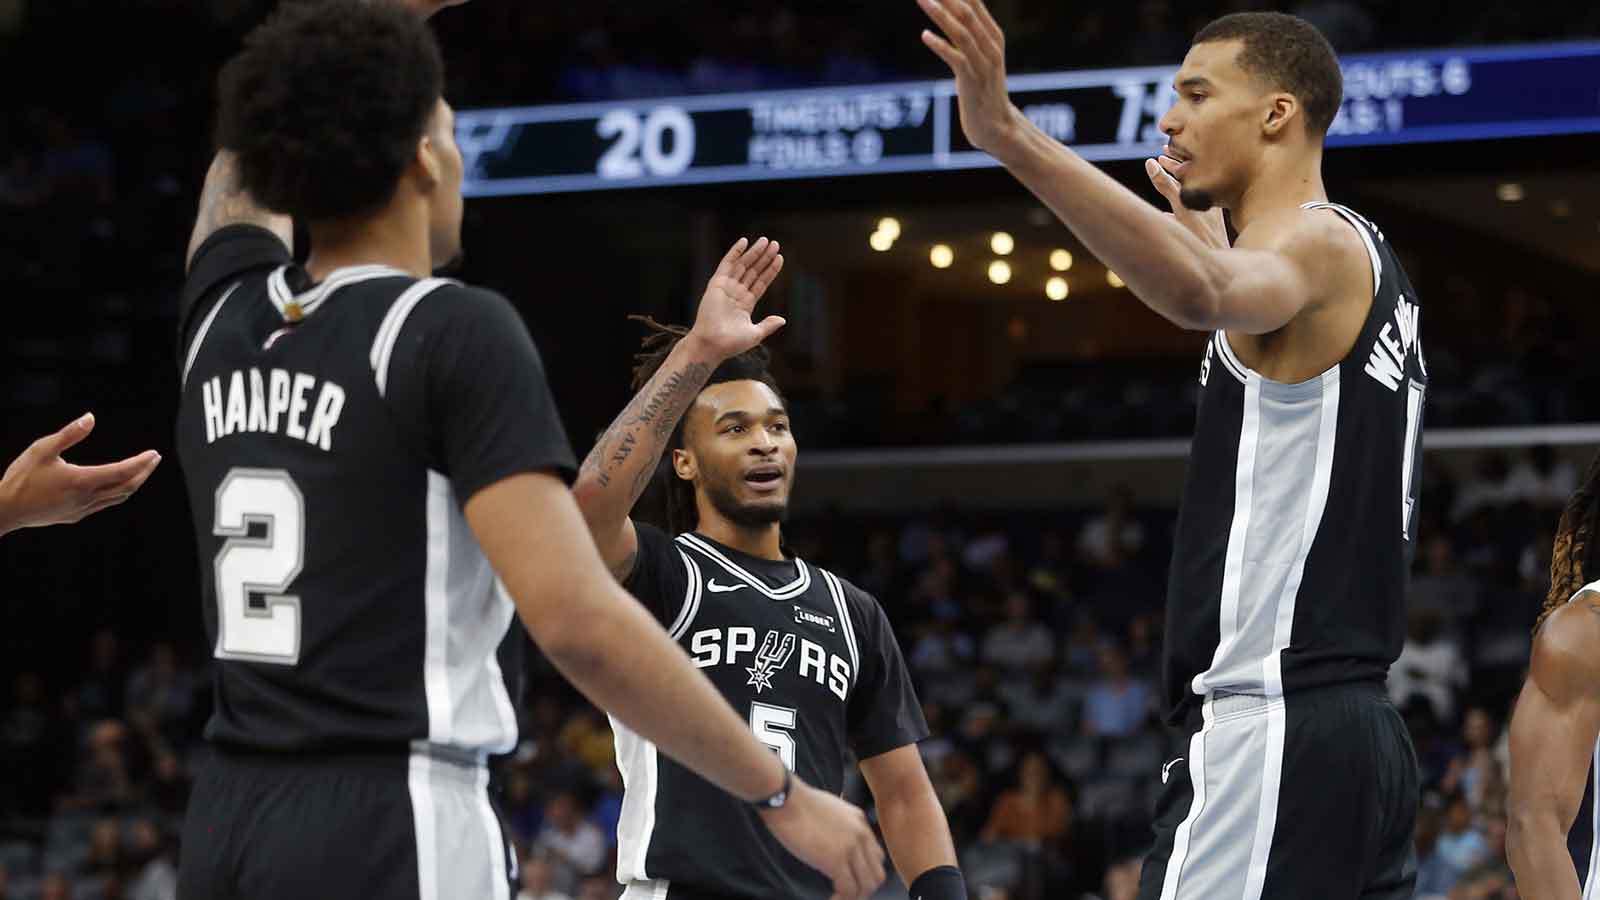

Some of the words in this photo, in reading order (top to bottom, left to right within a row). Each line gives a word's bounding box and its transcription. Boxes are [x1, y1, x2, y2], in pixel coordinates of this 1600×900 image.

[596, 105, 696, 180] 20
[202, 366, 346, 452] HARPER
[212, 466, 306, 666] 2
[690, 626, 851, 702] SPURS
[750, 700, 797, 773] 5
